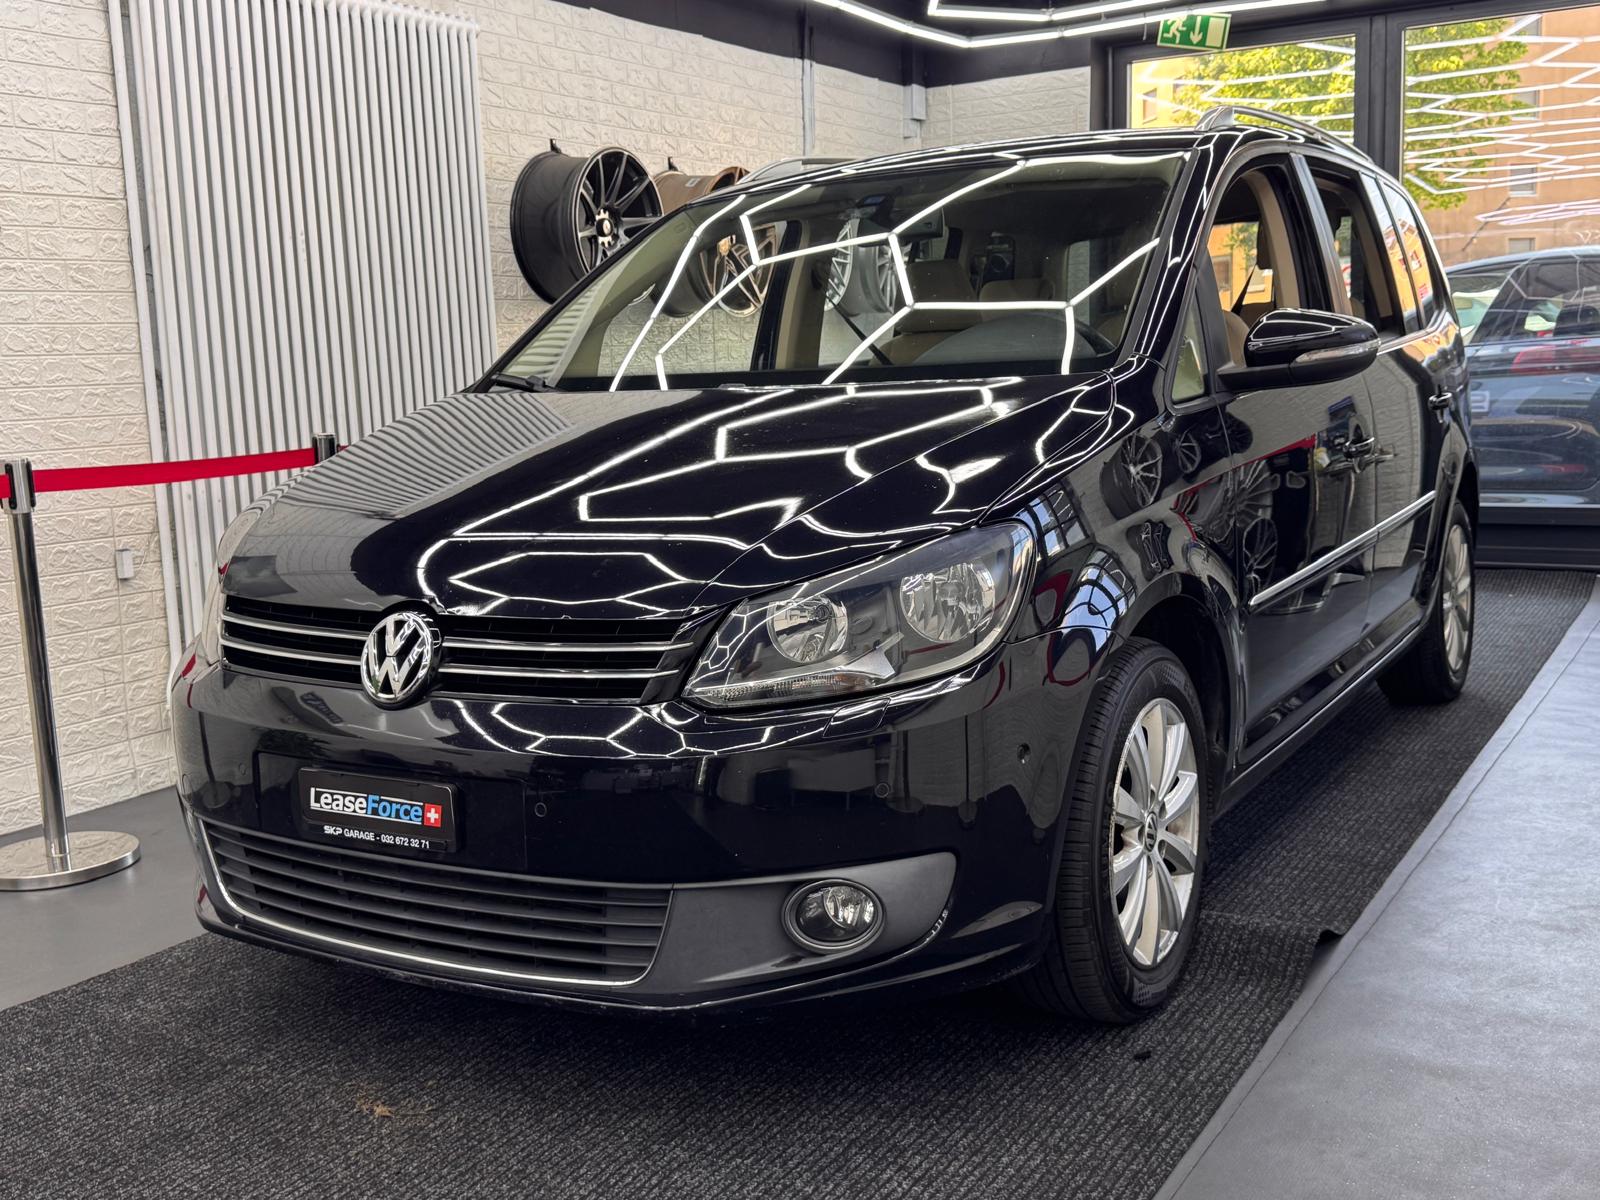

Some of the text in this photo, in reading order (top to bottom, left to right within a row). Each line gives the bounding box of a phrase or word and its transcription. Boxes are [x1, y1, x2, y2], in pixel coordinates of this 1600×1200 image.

[361, 612, 431, 702] VW
[310, 787, 422, 822] LeaseForce
[323, 825, 343, 835] SKP
[344, 828, 375, 841] GARAGE
[381, 834, 394, 844] 032
[395, 836, 409, 846] 672
[410, 839, 419, 848] 32
[421, 840, 430, 849] 71
